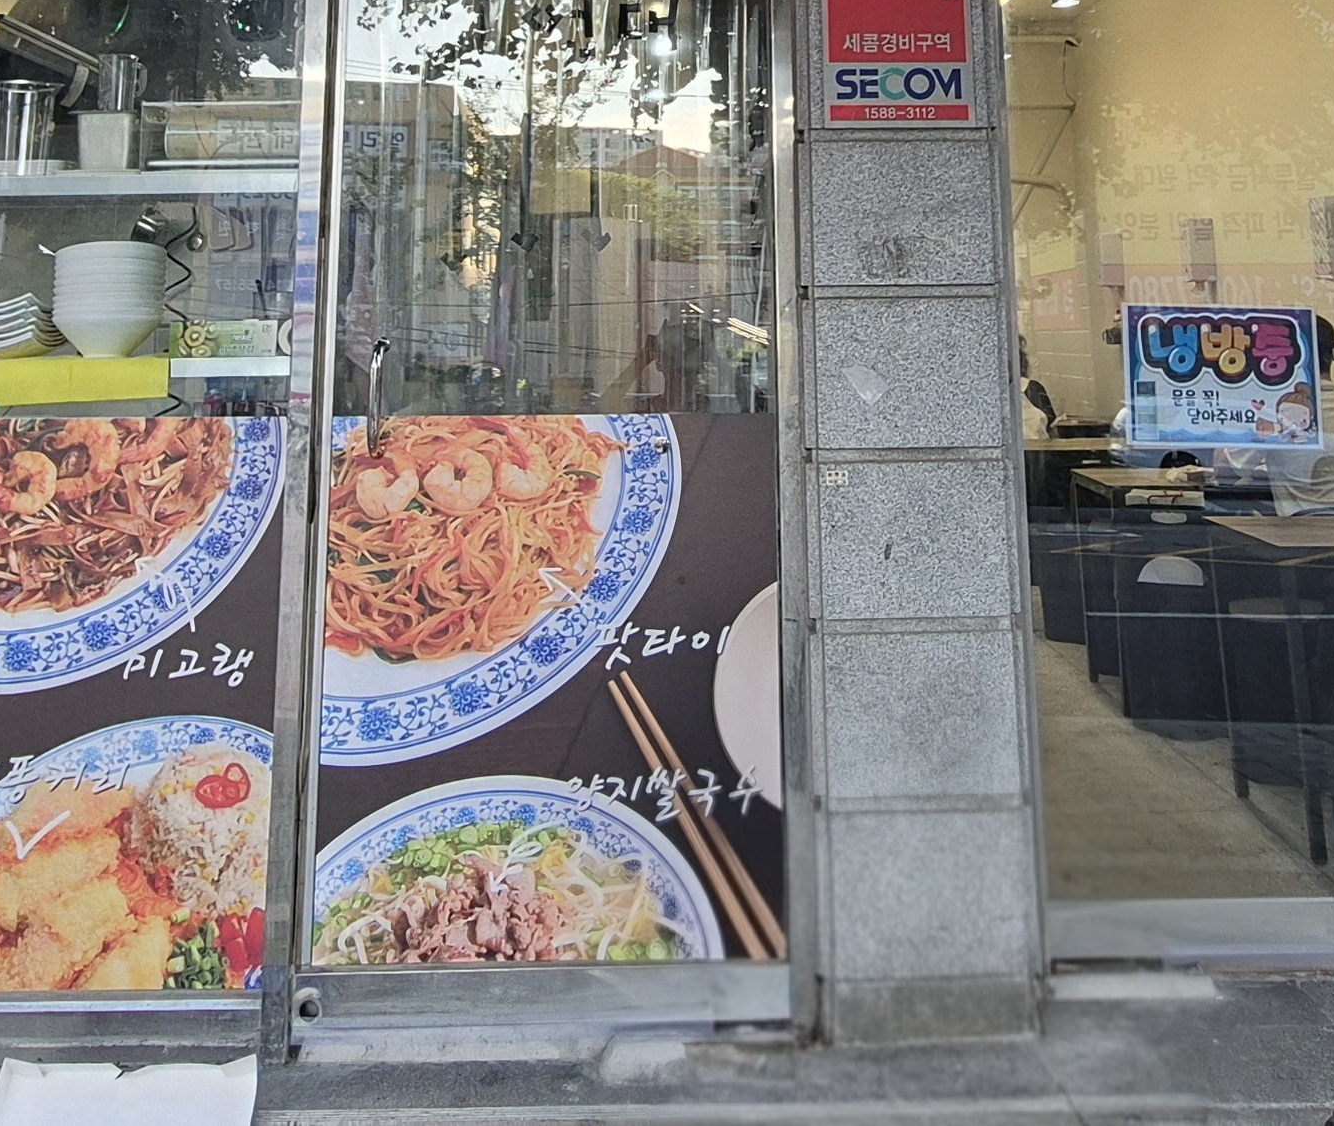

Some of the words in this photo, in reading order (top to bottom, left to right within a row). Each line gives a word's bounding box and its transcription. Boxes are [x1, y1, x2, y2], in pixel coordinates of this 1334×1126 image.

[842, 32, 952, 54] 세콤경비구역
[835, 66, 963, 101] SECOM
[863, 106, 937, 120] 1588-3112
[1171, 389, 1197, 407] 문을
[1202, 389, 1220, 408] 꼭!
[1188, 408, 1256, 426] 닫아주세요
[595, 621, 730, 671] 팟타이
[122, 642, 255, 688] 미고랭
[566, 764, 764, 823] 양지쌀국수
